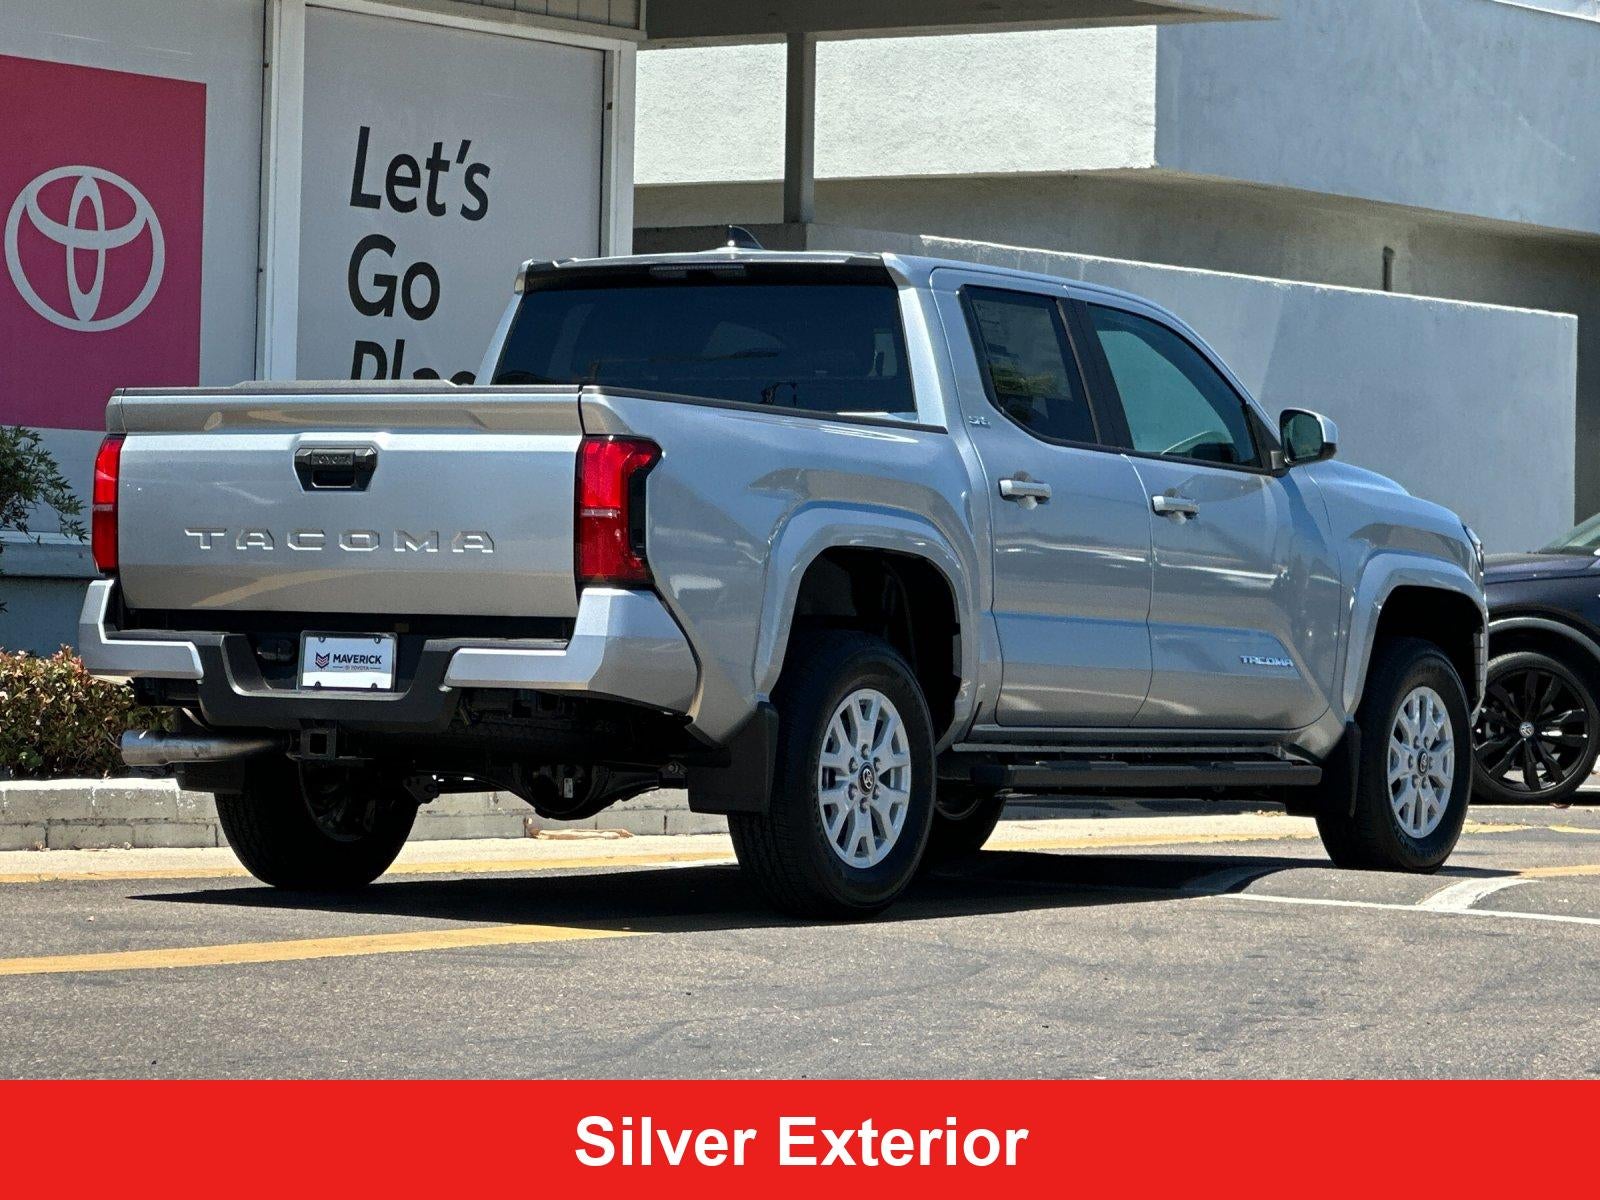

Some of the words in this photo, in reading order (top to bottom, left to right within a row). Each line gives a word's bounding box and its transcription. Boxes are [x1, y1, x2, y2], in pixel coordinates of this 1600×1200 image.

[348, 234, 440, 321] Go
[184, 527, 495, 553] TACOMA
[333, 653, 382, 664] MAVERICK
[1240, 655, 1294, 667] TACOMA
